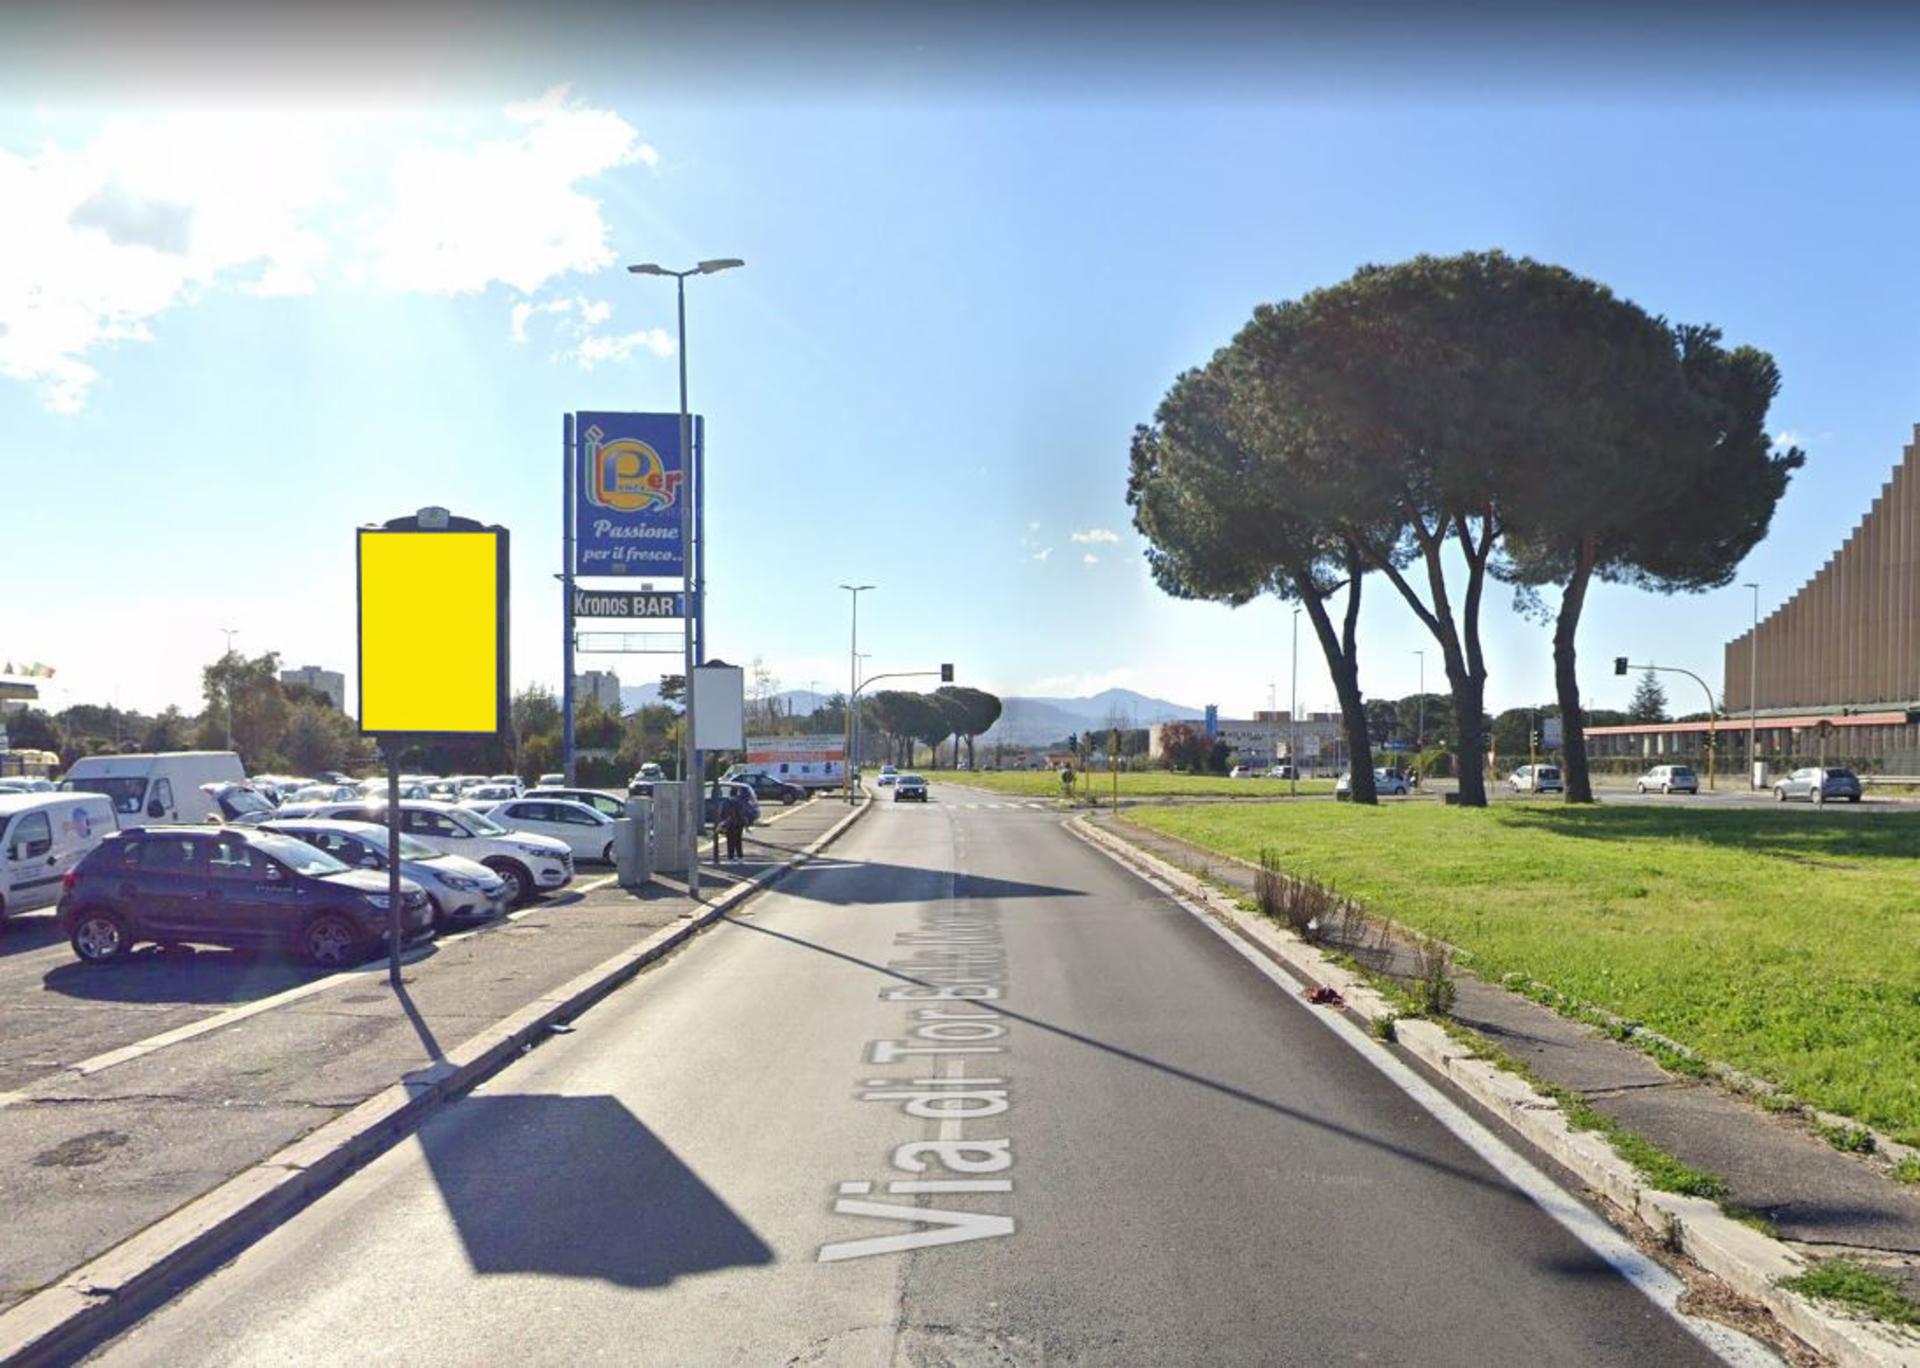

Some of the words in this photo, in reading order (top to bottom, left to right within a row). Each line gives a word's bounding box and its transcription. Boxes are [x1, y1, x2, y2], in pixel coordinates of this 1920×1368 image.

[593, 519, 680, 539] Passione
[583, 548, 611, 562] per
[612, 546, 625, 559] il
[574, 592, 629, 615] Kronos
[633, 596, 674, 616] BAR
